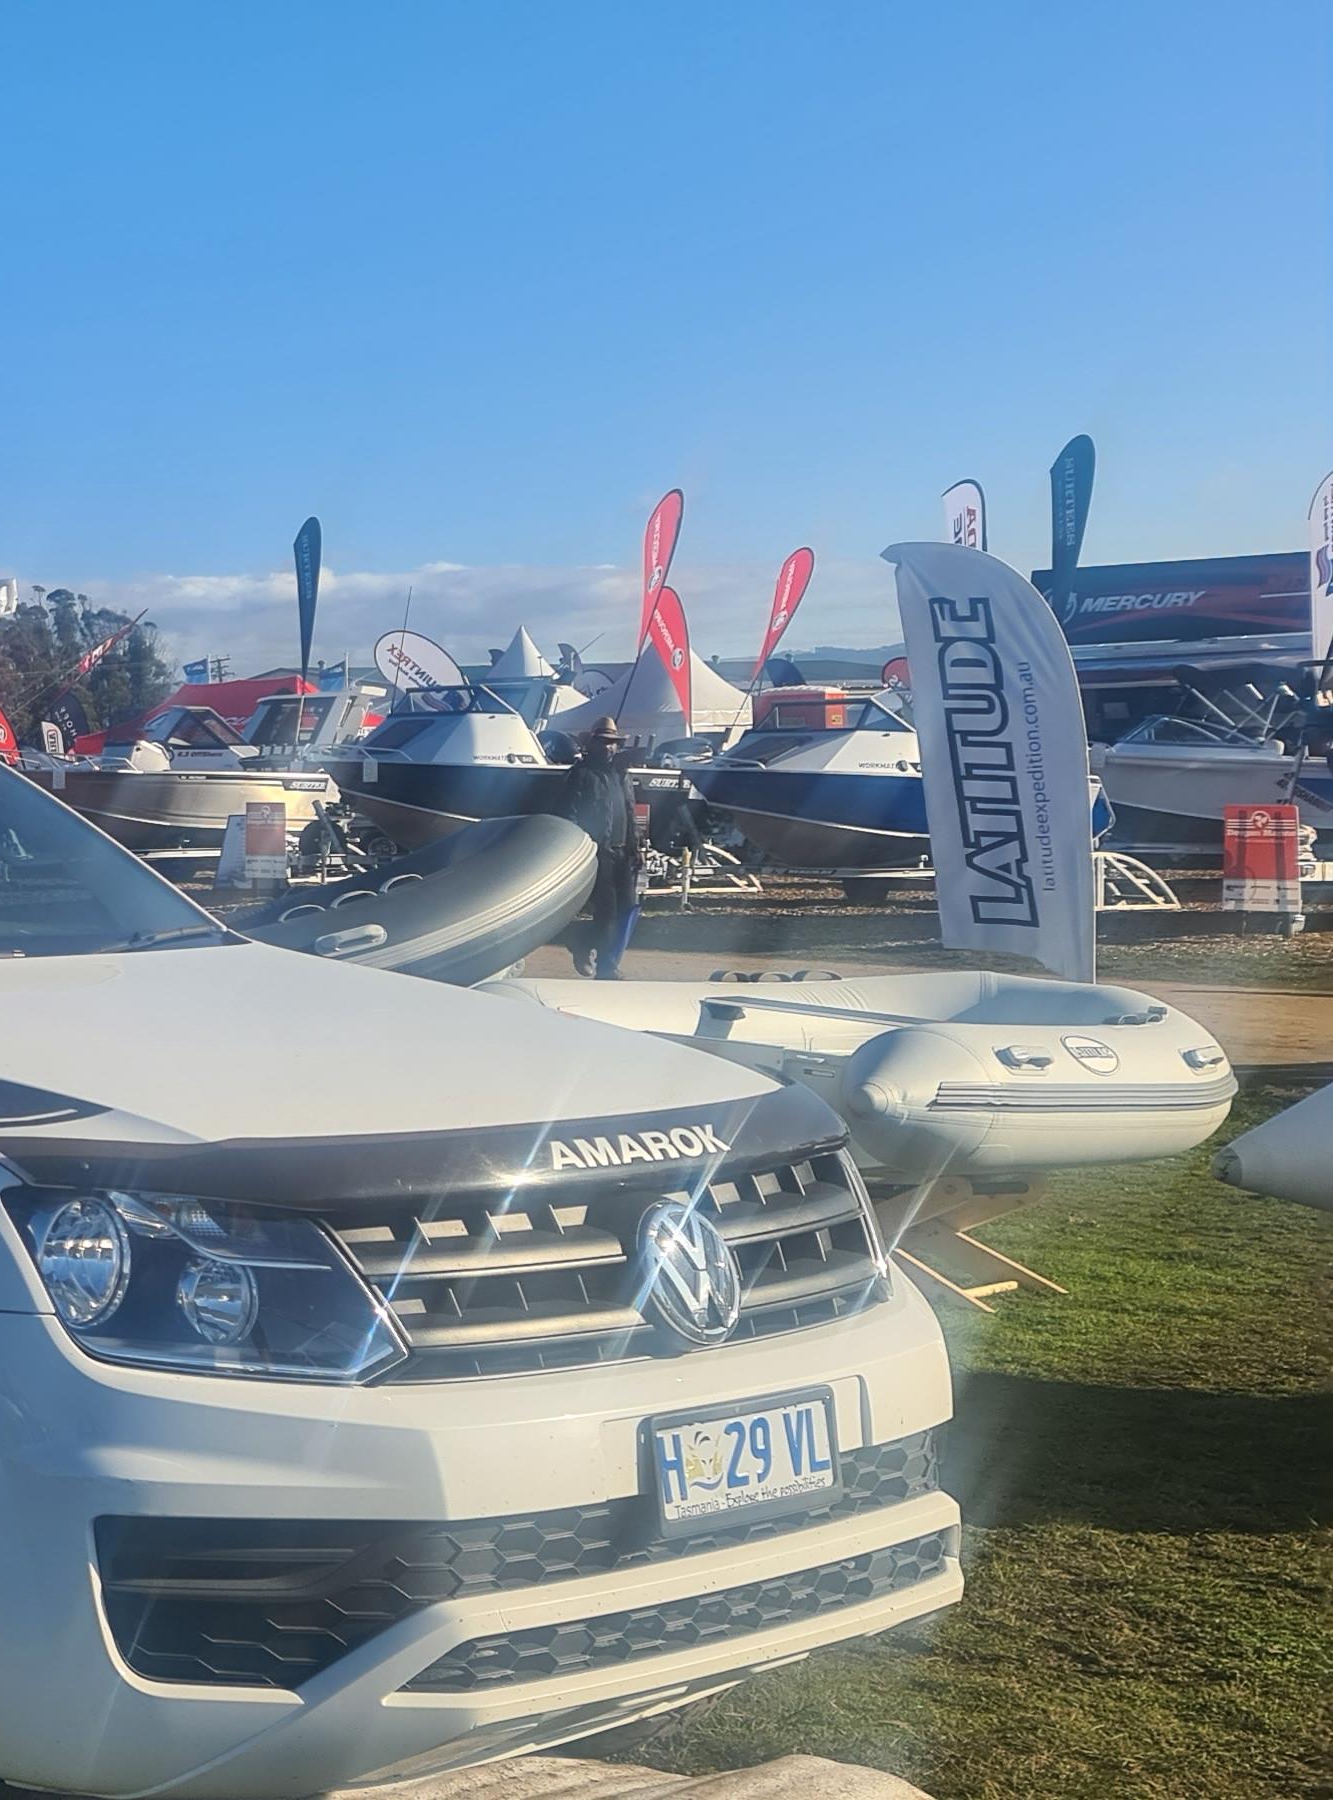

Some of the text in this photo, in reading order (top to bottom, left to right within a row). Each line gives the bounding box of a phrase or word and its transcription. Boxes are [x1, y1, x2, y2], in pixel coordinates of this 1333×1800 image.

[1080, 590, 1207, 613] MERCURY
[928, 596, 1040, 929] LATITUDE
[1016, 661, 1055, 892] latitudeexpedition.com.au
[550, 1123, 732, 1171] AMAROK
[724, 1416, 773, 1489] 29
[781, 1407, 832, 1477] VL
[674, 1496, 721, 1519] Tasmania
[725, 1490, 760, 1508] Explore
[761, 1485, 778, 1499] the
